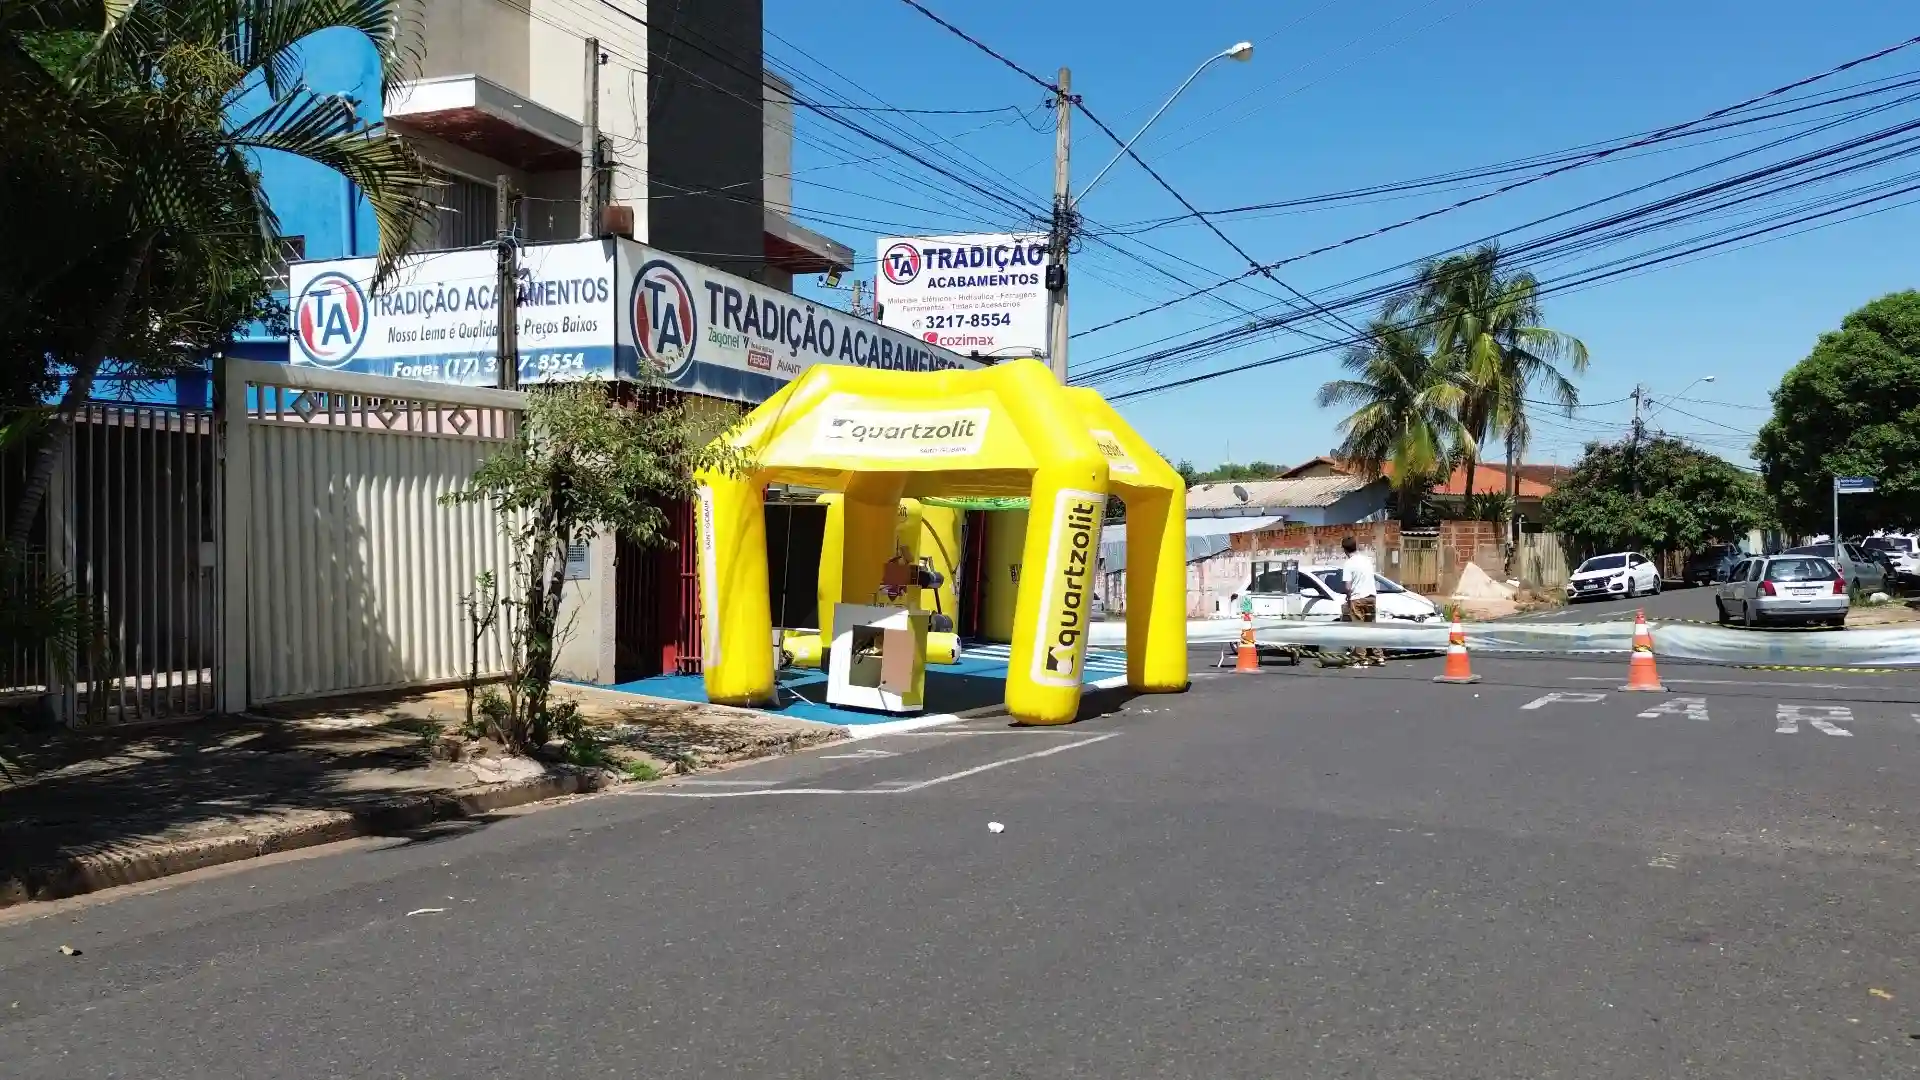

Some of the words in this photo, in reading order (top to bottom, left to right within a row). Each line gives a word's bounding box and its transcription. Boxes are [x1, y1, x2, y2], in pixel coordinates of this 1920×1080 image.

[890, 254, 914, 276] TA
[923, 239, 1043, 272] TRADIÇÃO
[928, 273, 1039, 288] ACABAMENTOS
[373, 282, 460, 319] TRADIÇÃO
[465, 277, 609, 311] ACAAMENTOS
[309, 289, 352, 345] TA
[388, 326, 417, 343] Nosso
[421, 325, 446, 341] Lema
[459, 320, 498, 339] Qualida
[524, 319, 558, 339] Preços
[563, 315, 598, 333] Baixos
[645, 279, 682, 353] TA
[705, 280, 835, 357] TRADIÇÃO
[839, 326, 965, 372] ACABAMEN
[926, 313, 1011, 328] 3217-8554
[940, 334, 994, 346] cozimax
[393, 361, 439, 377] Fone:
[445, 357, 479, 379] (17)
[484, 352, 584, 373] 37-8554
[852, 420, 976, 442] quartzolit
[1059, 503, 1094, 646] quartzolit
